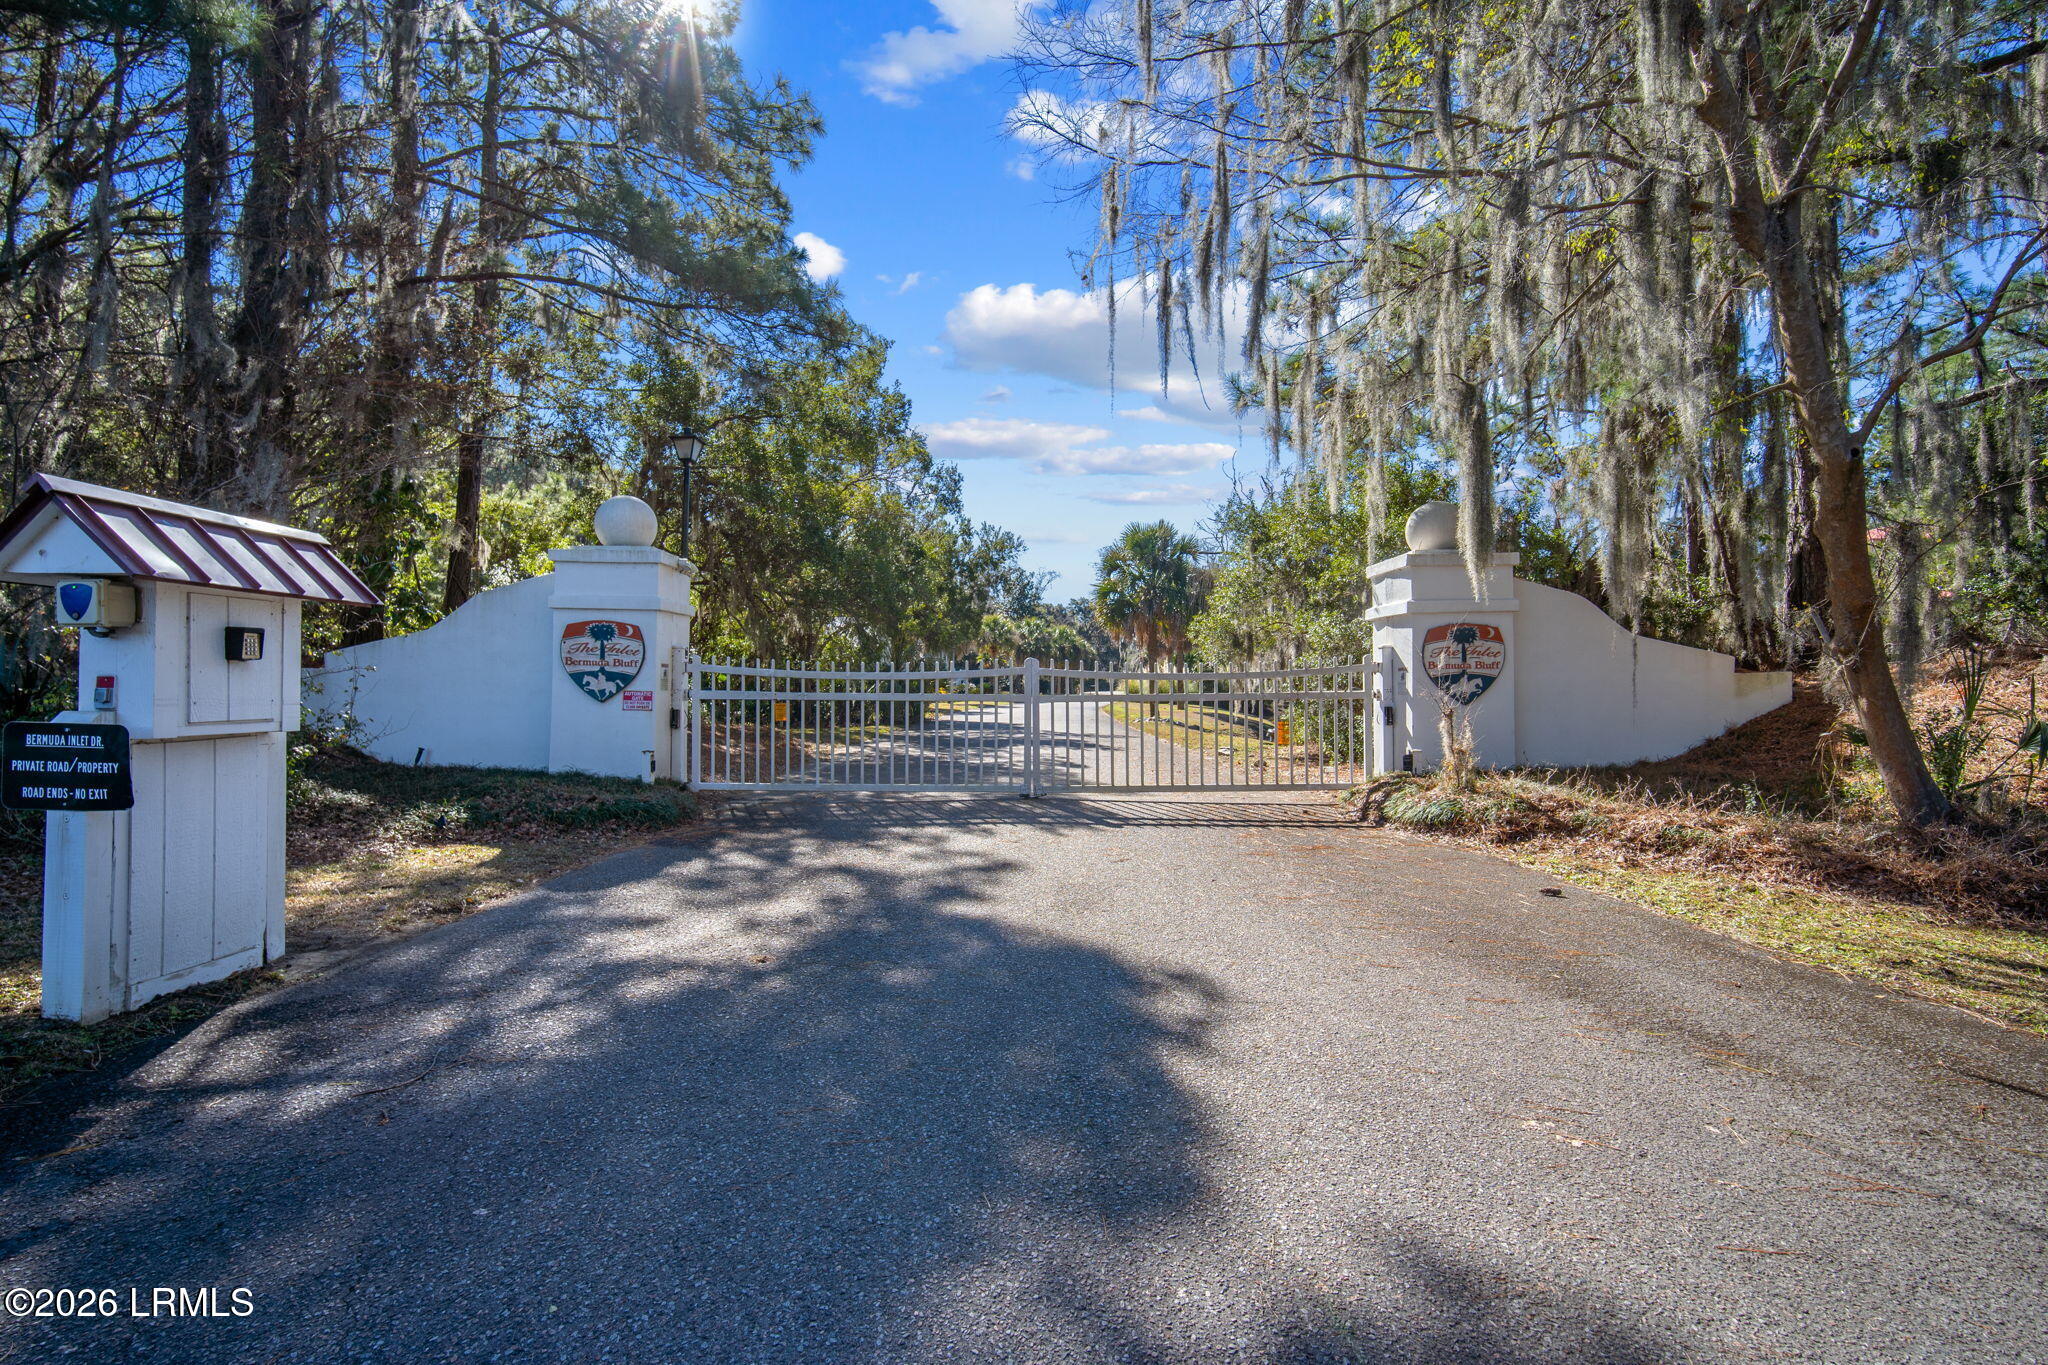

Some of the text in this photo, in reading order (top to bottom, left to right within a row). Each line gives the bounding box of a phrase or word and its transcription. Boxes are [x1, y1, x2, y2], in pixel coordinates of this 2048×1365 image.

[567, 642, 640, 656] The Inlet
[1465, 645, 1502, 658] Inlet
[565, 656, 640, 668] Bermuda Bluff
[1428, 660, 1501, 670] Bmuda Bluff
[26, 734, 104, 747] BERMUDA INLET DR.
[12, 760, 45, 772] PRIVATE
[22, 786, 45, 799] ROAD
[89, 788, 108, 800] EXIT
